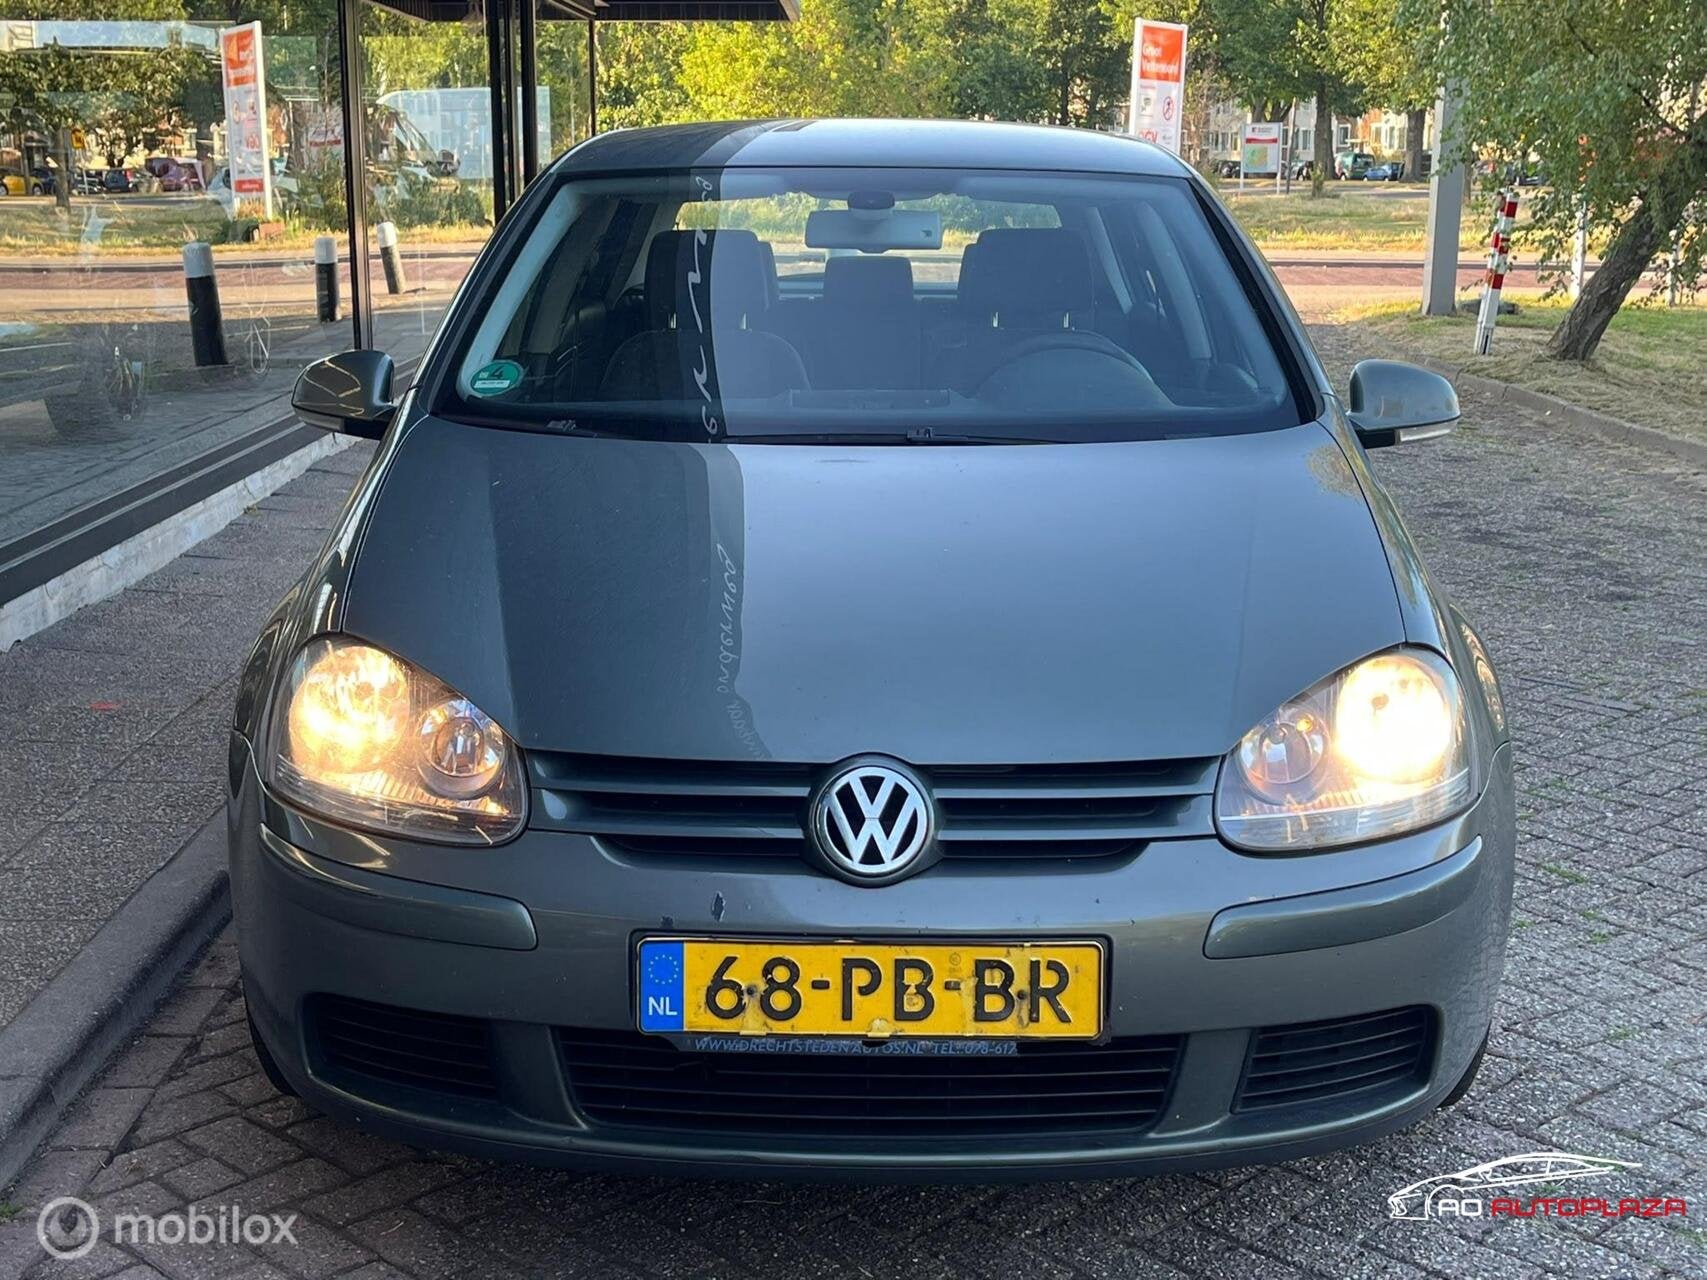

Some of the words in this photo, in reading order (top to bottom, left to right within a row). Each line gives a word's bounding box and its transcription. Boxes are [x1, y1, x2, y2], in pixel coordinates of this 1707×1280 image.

[490, 364, 506, 379] 4
[705, 955, 1073, 1024] 68-PB-BR
[648, 997, 678, 1016] NL
